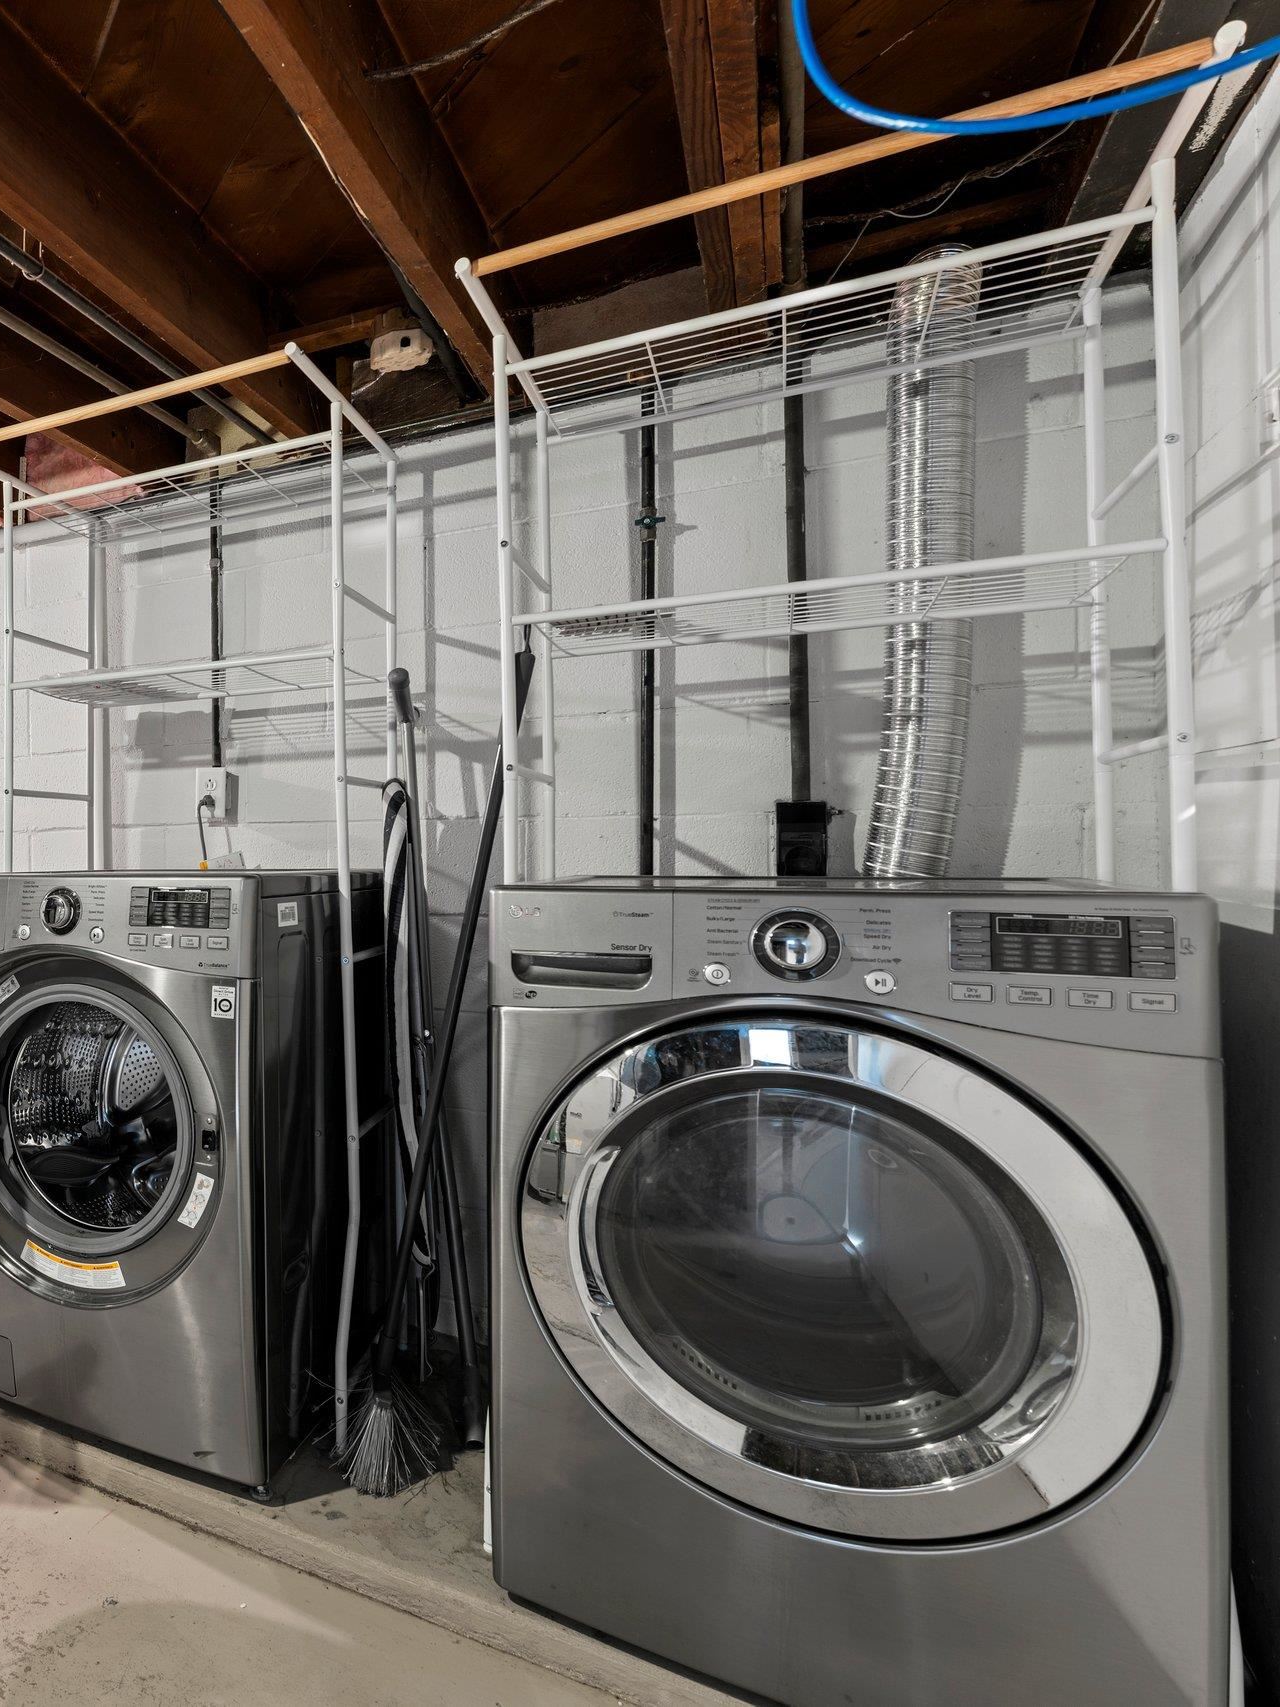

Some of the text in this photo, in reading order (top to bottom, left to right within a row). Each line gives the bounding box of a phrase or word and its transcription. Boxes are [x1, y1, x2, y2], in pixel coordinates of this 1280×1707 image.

[610, 943, 653, 952] Sensor Dry
[213, 998, 233, 1013] 10
[1084, 998, 1096, 1006] Dry
[1141, 998, 1164, 1006] Signal
